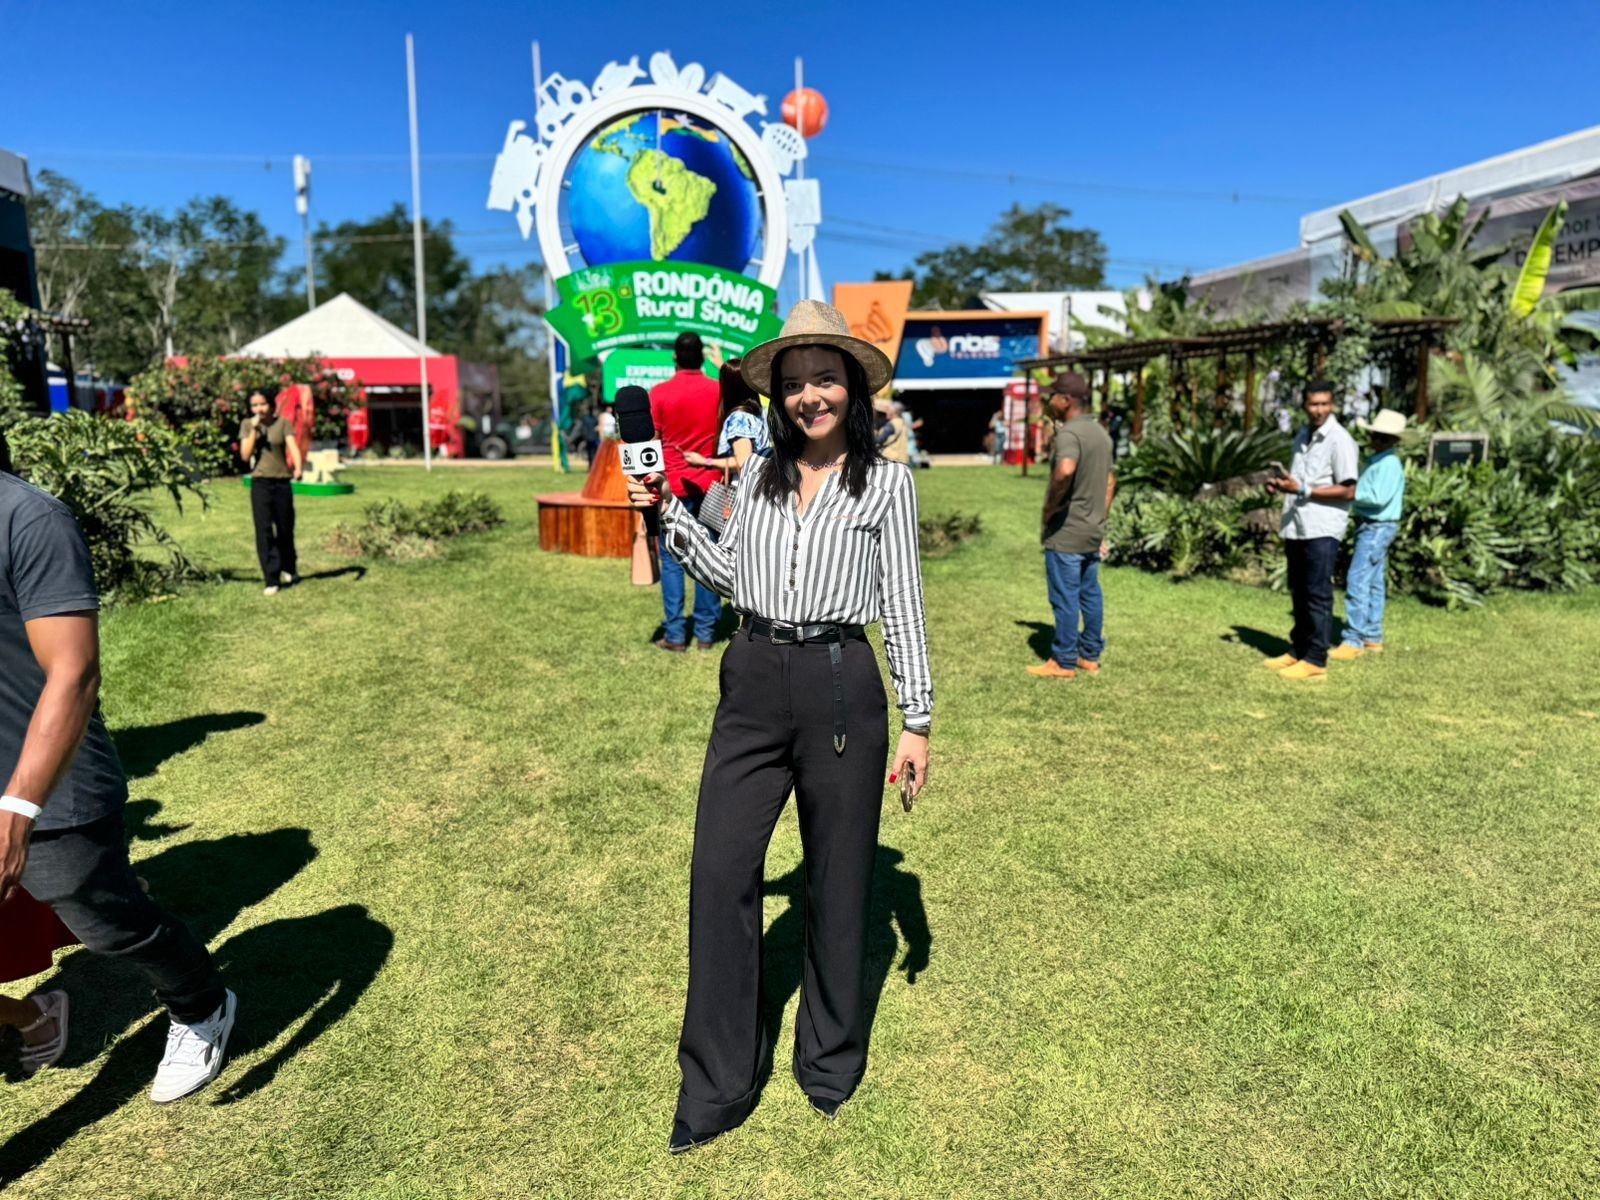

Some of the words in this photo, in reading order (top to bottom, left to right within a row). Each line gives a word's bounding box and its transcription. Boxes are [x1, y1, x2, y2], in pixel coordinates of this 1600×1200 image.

[633, 271, 764, 315] RONDÔNIA
[635, 295, 695, 318] Rural
[699, 299, 758, 334] Show
